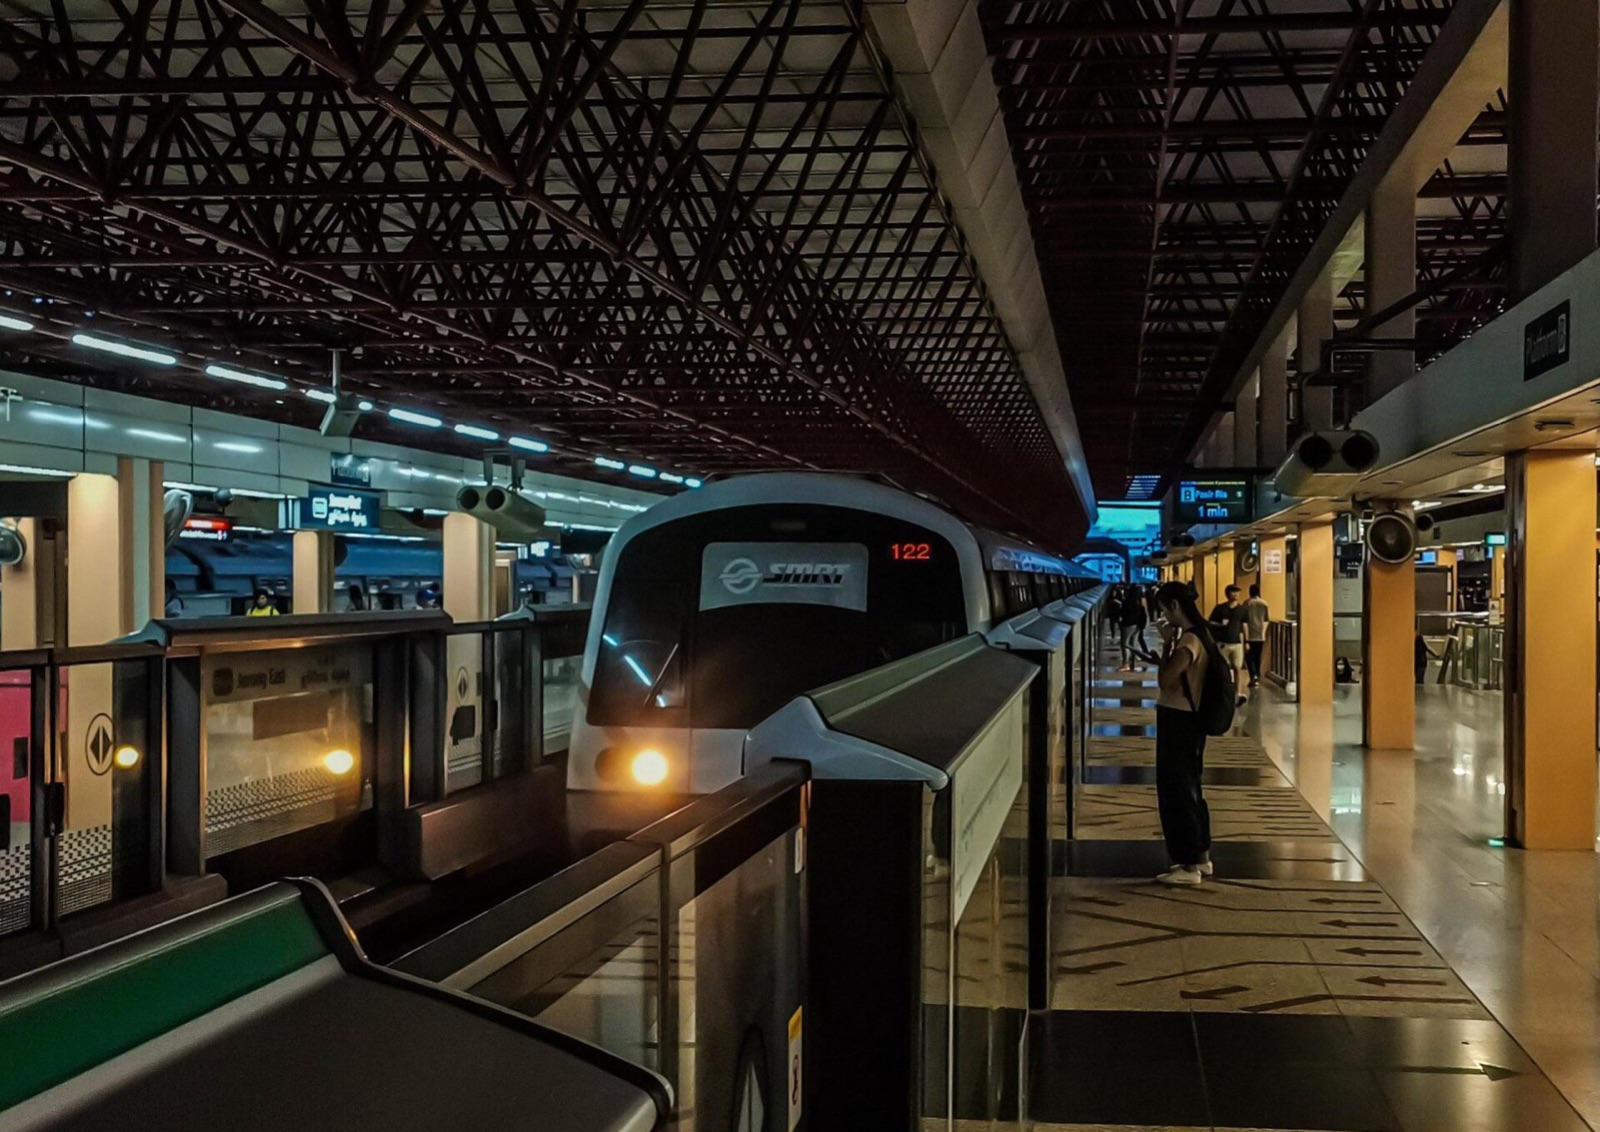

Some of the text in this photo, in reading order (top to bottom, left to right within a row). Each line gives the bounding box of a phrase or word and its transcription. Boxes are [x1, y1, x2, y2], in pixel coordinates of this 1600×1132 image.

[1184, 489, 1193, 500] B
[1198, 505, 1228, 518] 1 min
[891, 543, 931, 560] 122
[762, 563, 850, 585] SMRT
